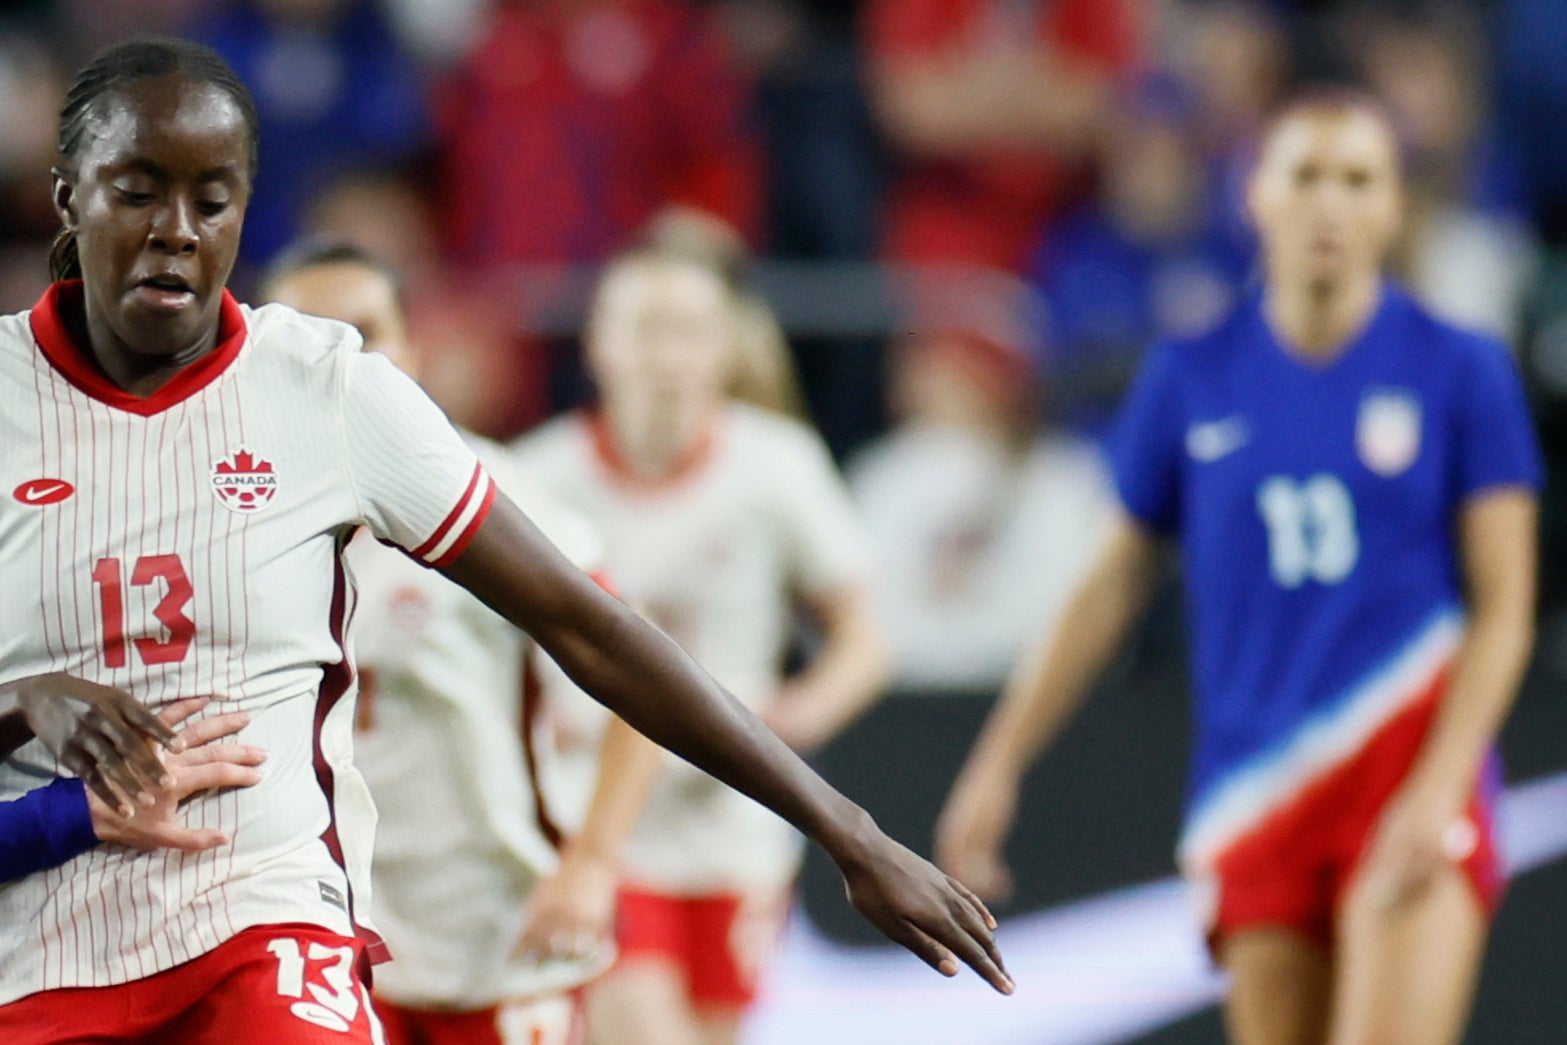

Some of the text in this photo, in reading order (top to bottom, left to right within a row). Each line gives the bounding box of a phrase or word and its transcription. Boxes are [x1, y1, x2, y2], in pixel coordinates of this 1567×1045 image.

[213, 475, 277, 486] CANADA
[92, 553, 196, 669] 13
[266, 937, 359, 1022] 13
